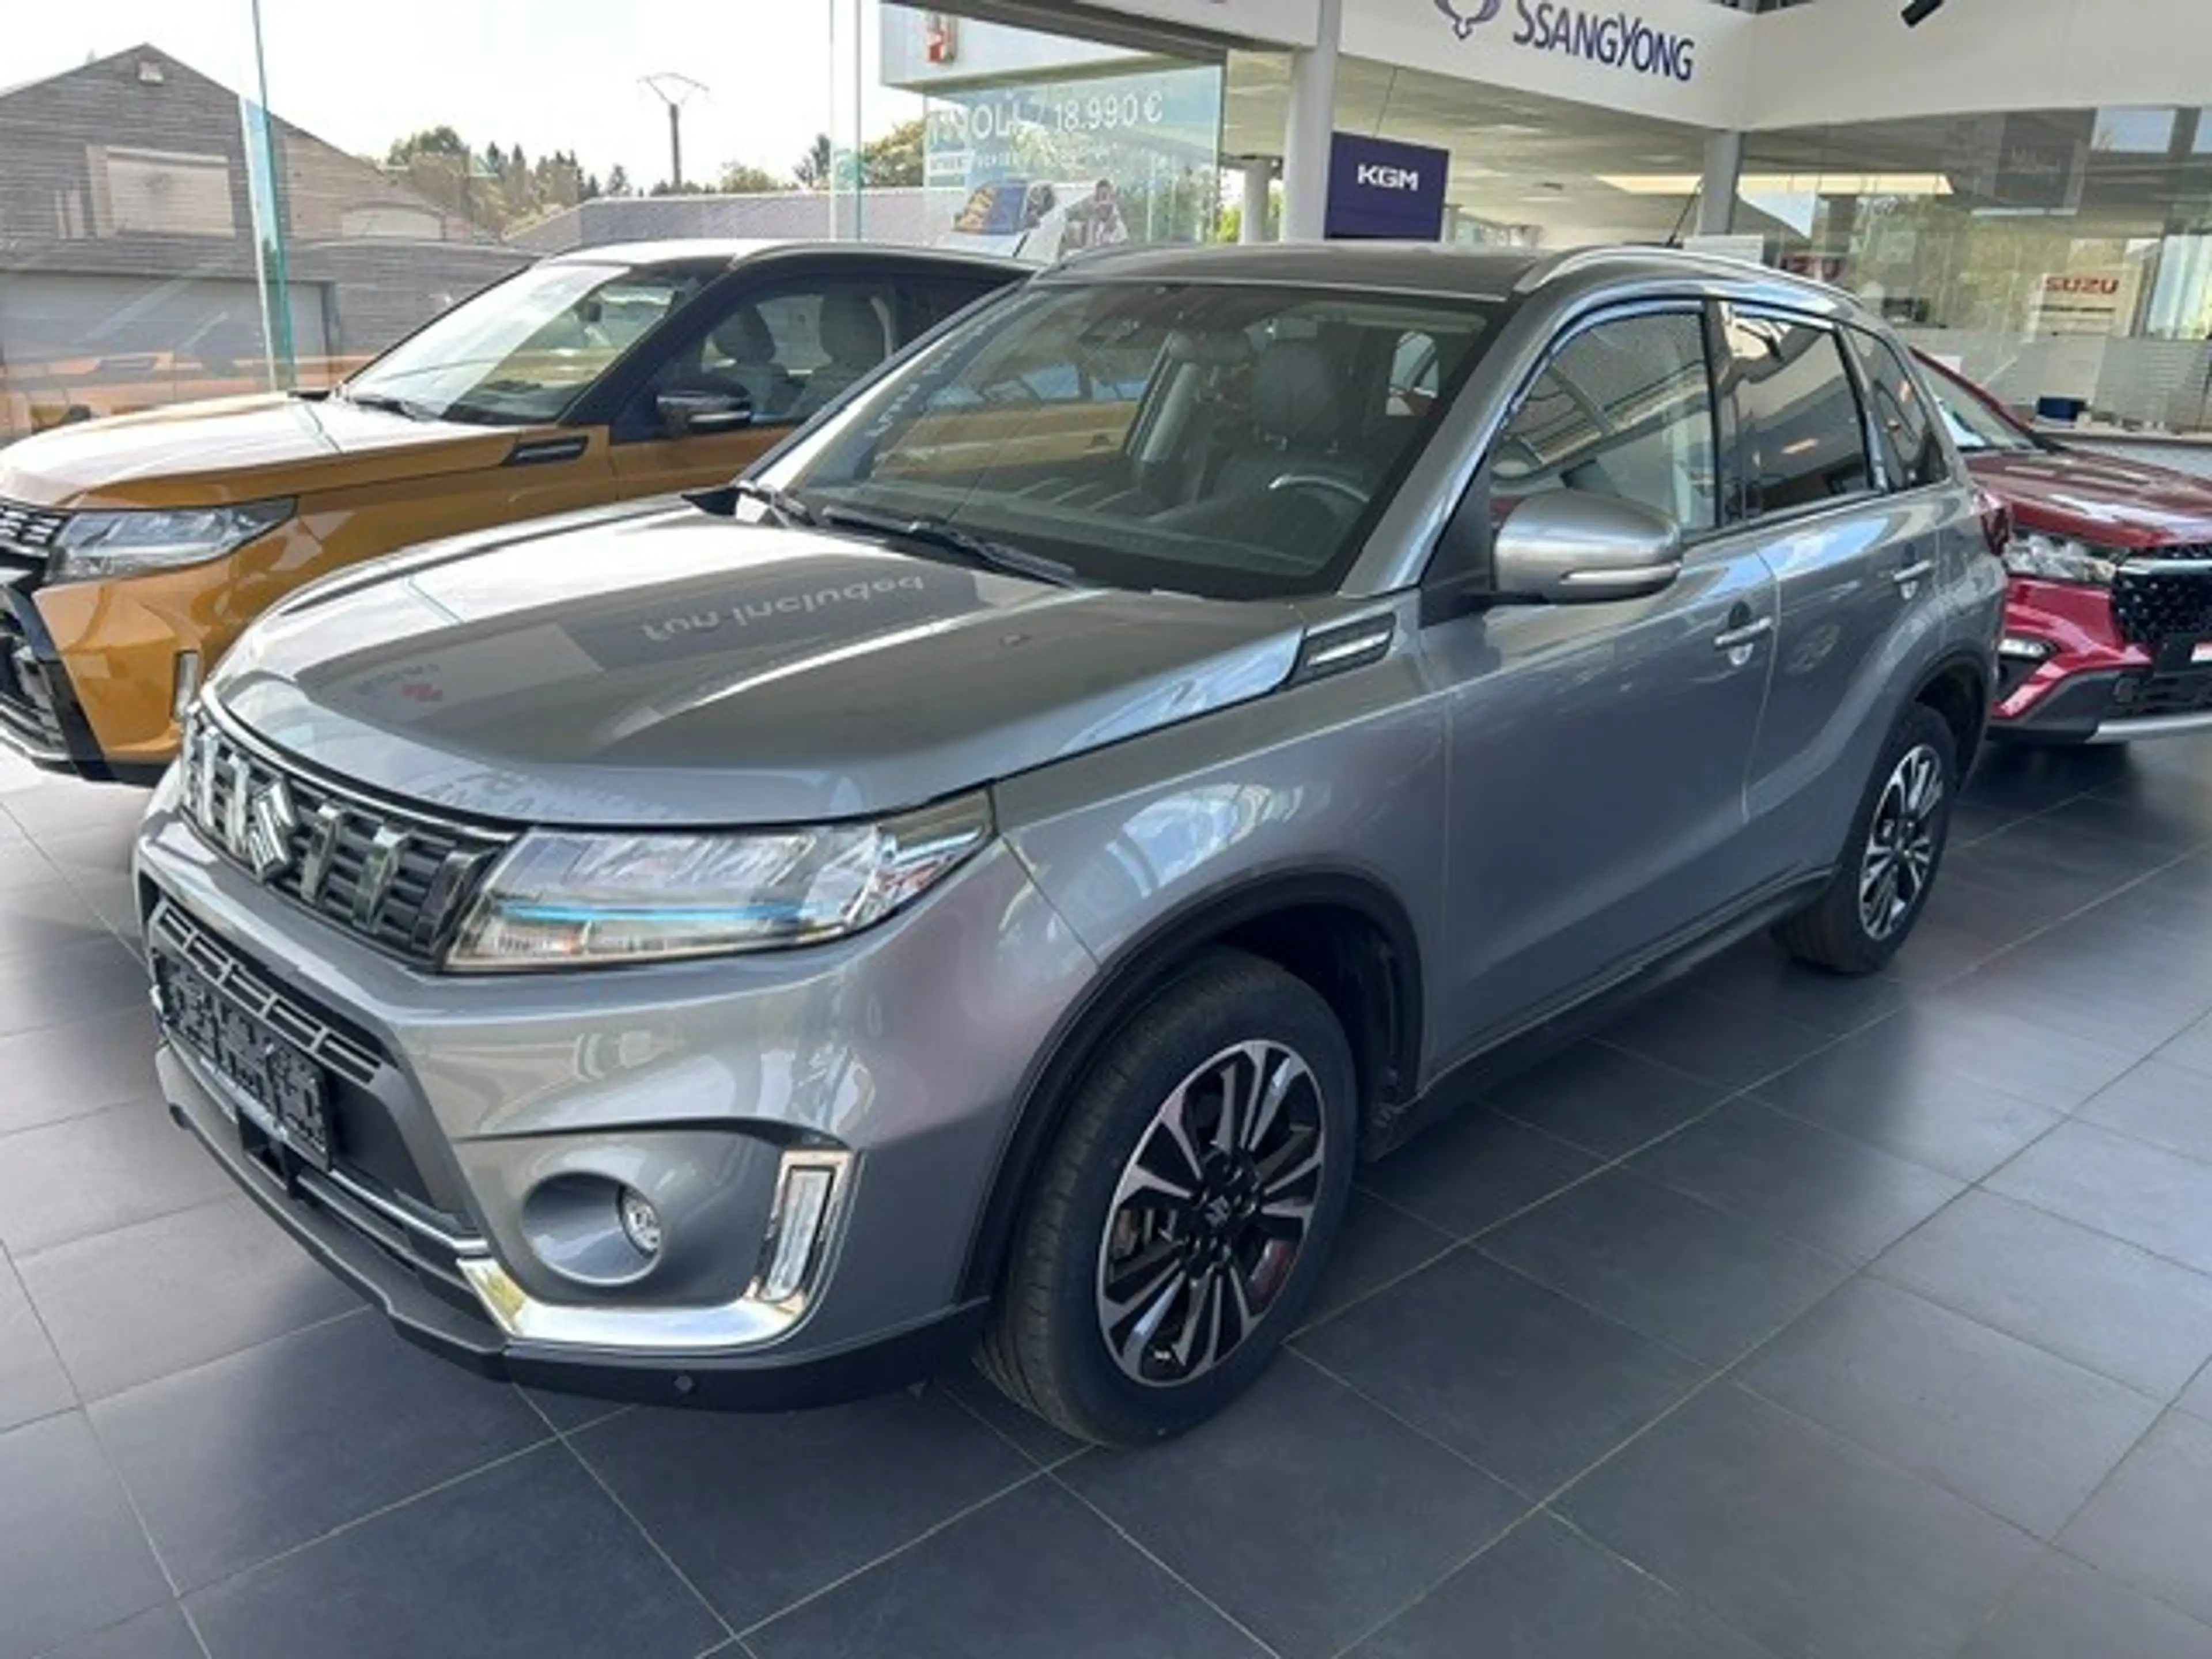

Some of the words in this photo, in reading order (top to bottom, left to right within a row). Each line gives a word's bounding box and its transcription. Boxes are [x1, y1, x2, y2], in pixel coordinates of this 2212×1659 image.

[1513, 0, 1694, 81] SSANGYONG
[1357, 164, 1419, 192] KGM
[2037, 276, 2120, 294] SUZU
